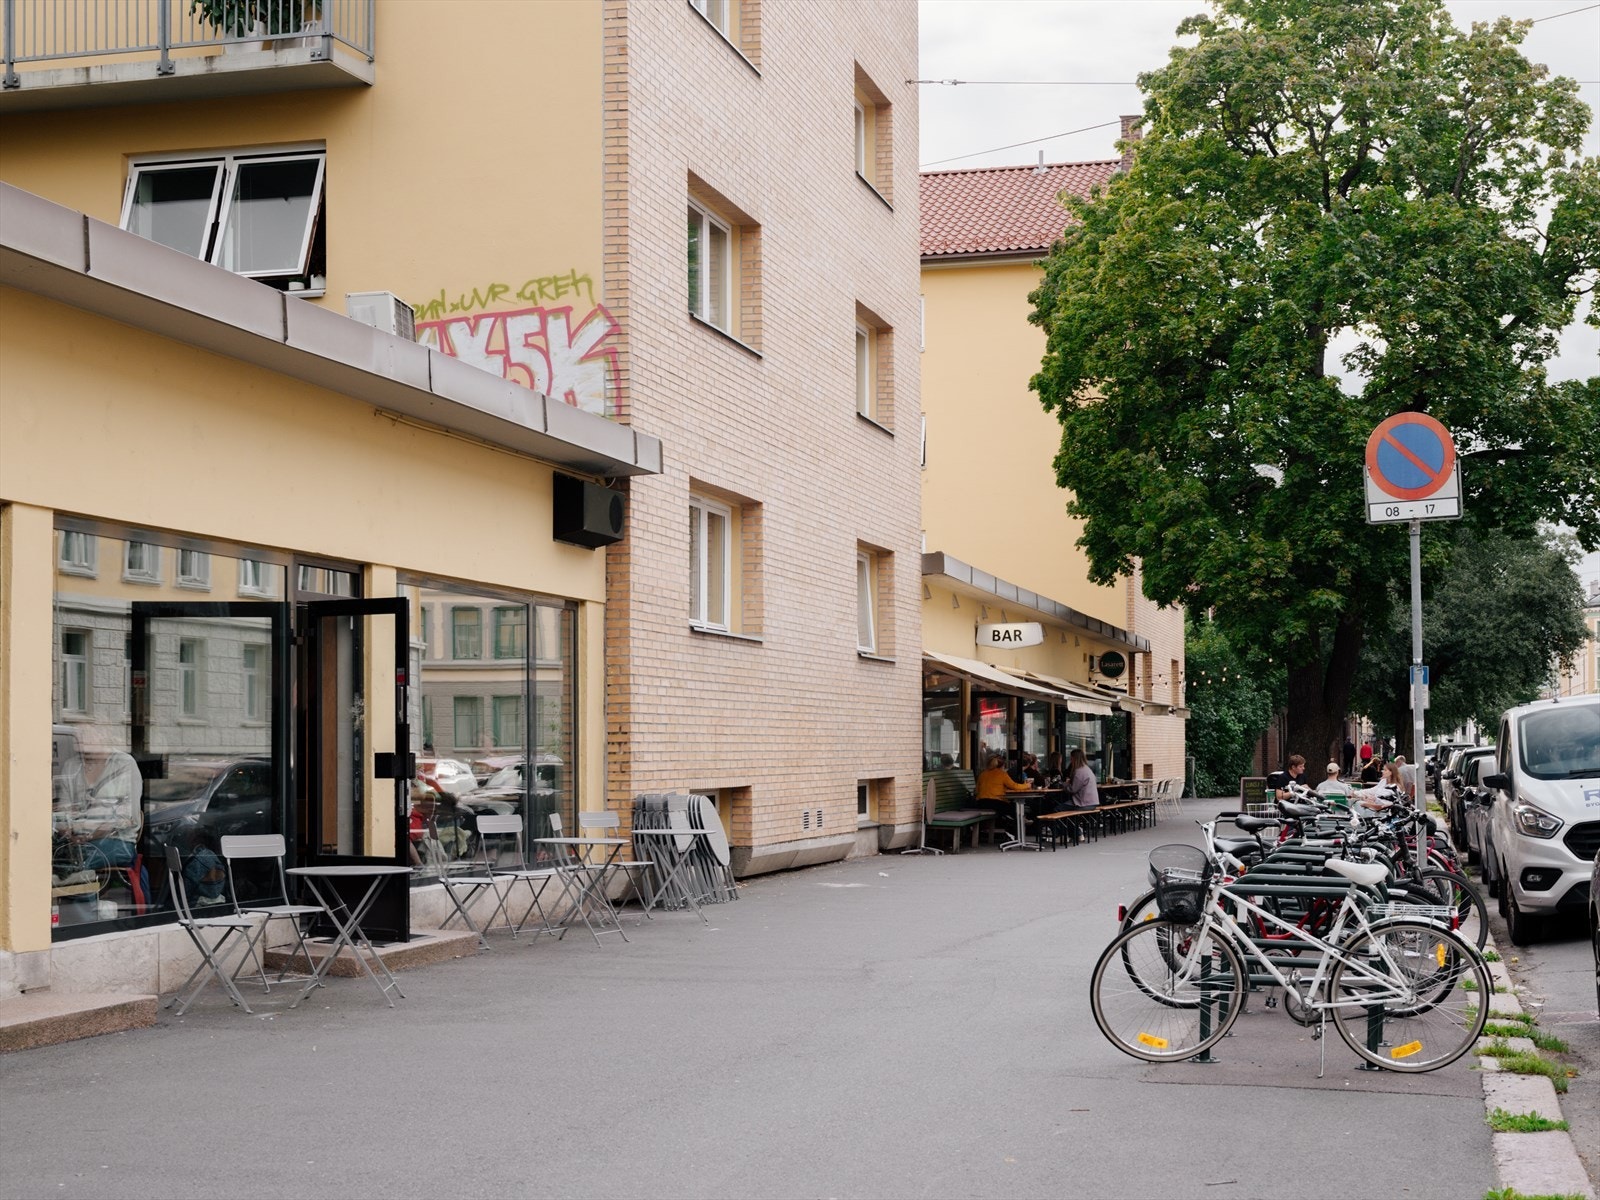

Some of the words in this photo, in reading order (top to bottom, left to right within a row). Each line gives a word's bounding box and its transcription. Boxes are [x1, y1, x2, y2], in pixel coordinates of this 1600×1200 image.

[1385, 506, 1400, 517] 08
[1425, 504, 1436, 514] 17
[992, 629, 1023, 642] BAR
